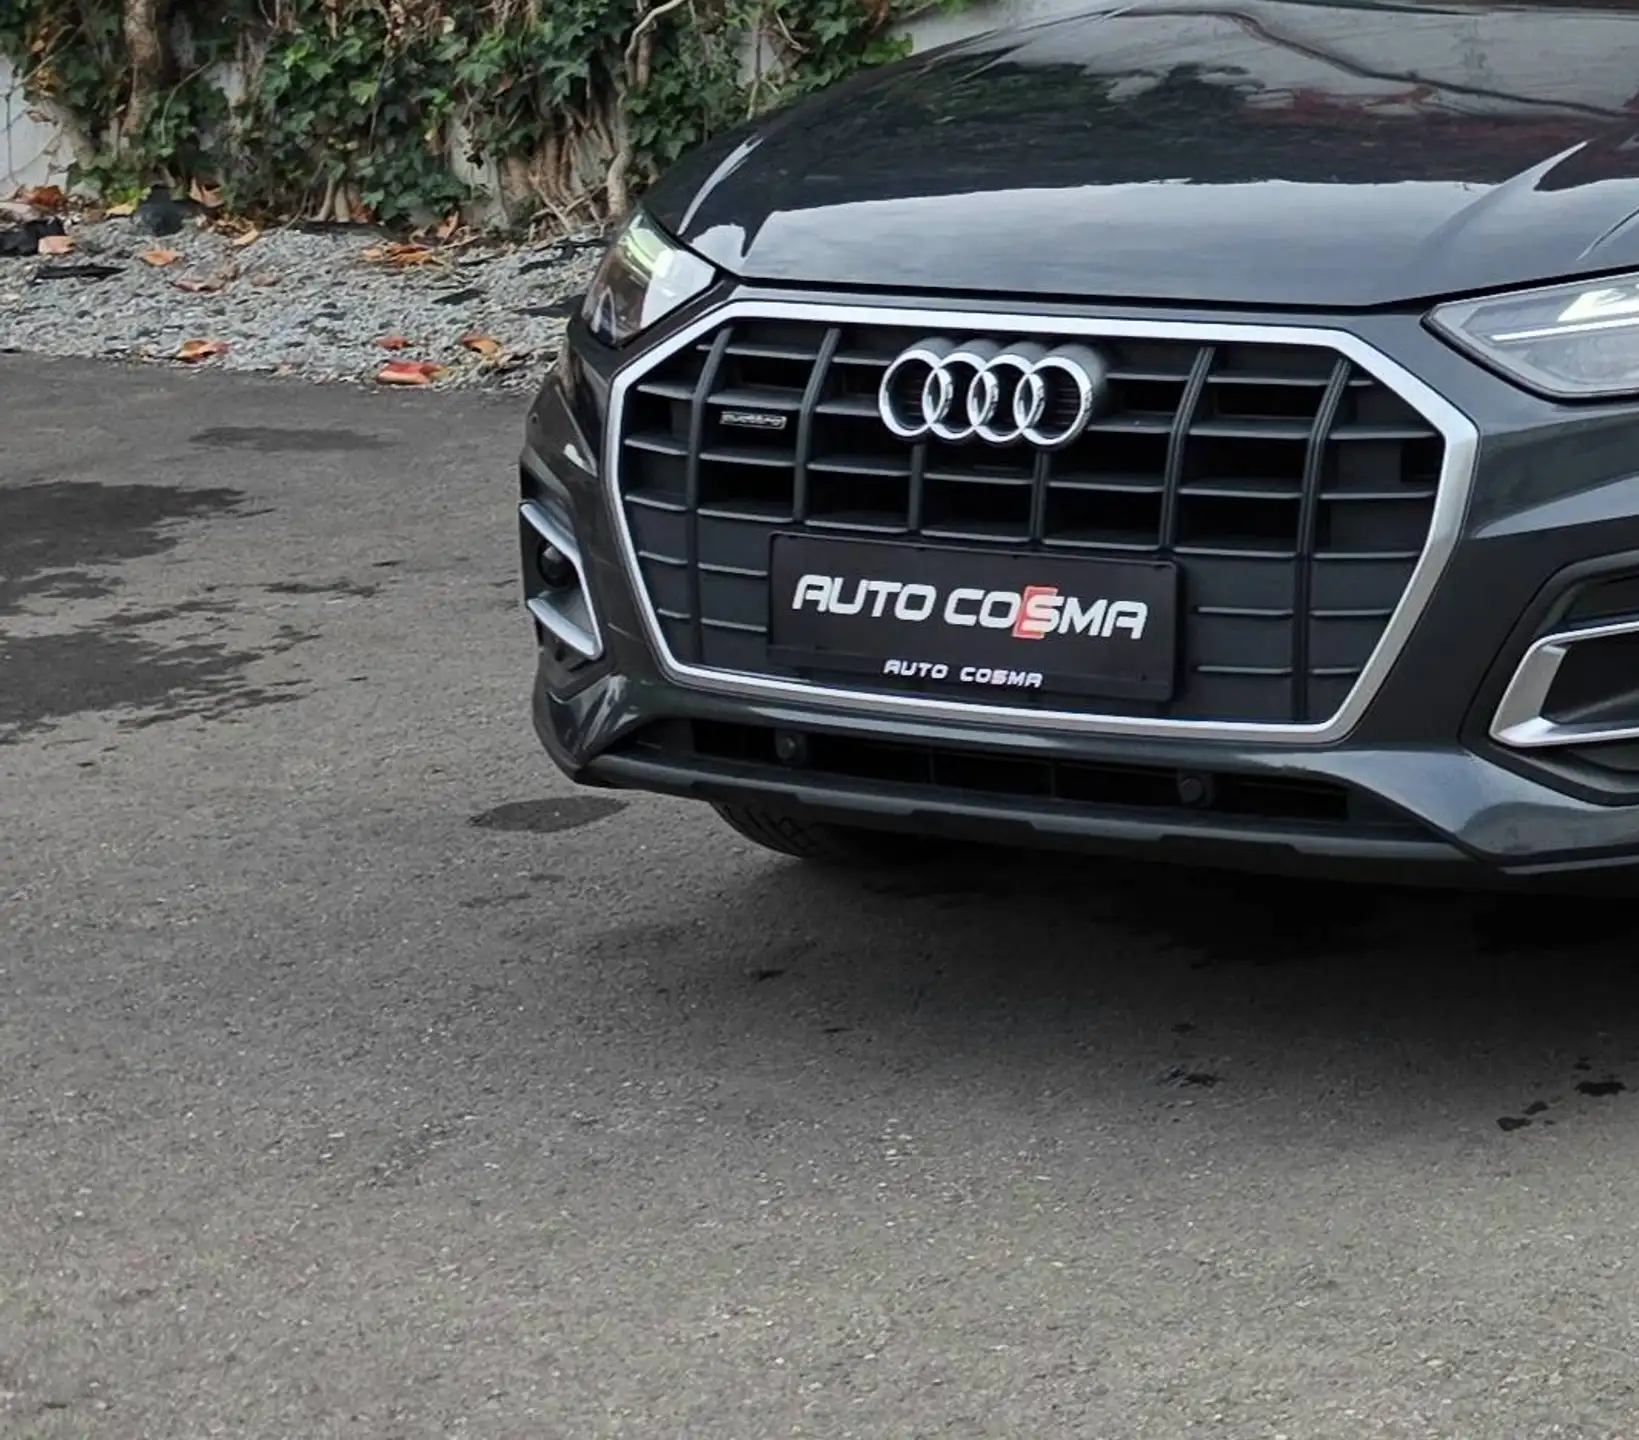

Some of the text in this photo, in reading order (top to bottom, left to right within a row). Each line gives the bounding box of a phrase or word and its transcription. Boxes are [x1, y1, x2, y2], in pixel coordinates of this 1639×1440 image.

[792, 574, 1148, 639] AUTO COSMA
[884, 660, 1043, 688] AUTO COSMA
